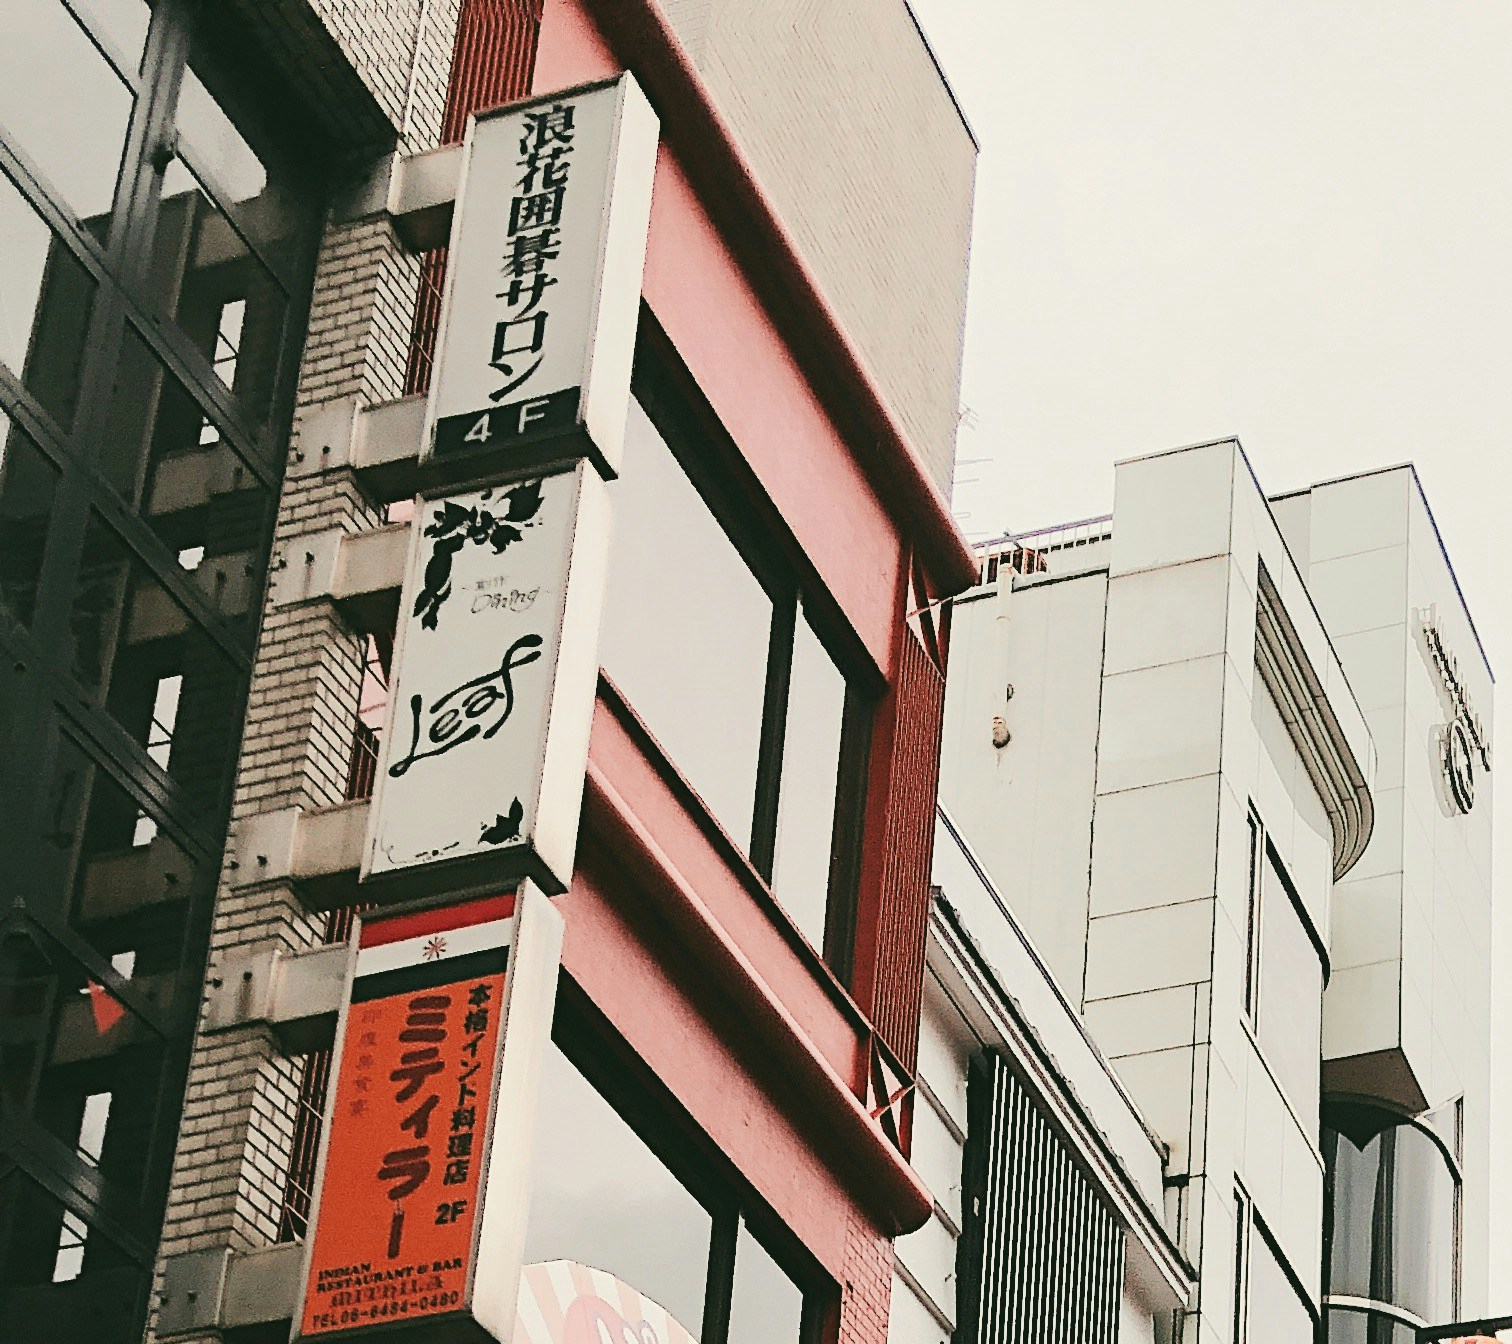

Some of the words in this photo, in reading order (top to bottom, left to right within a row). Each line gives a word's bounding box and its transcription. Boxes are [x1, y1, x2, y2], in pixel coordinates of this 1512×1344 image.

[486, 103, 577, 402] 浪花囲碁サロン
[388, 633, 546, 779] Leaf
[377, 995, 453, 1261] ミティラー
[434, 1199, 468, 1226] 2F
[318, 1262, 372, 1281] INDIAN
[432, 1256, 463, 1272] BAR
